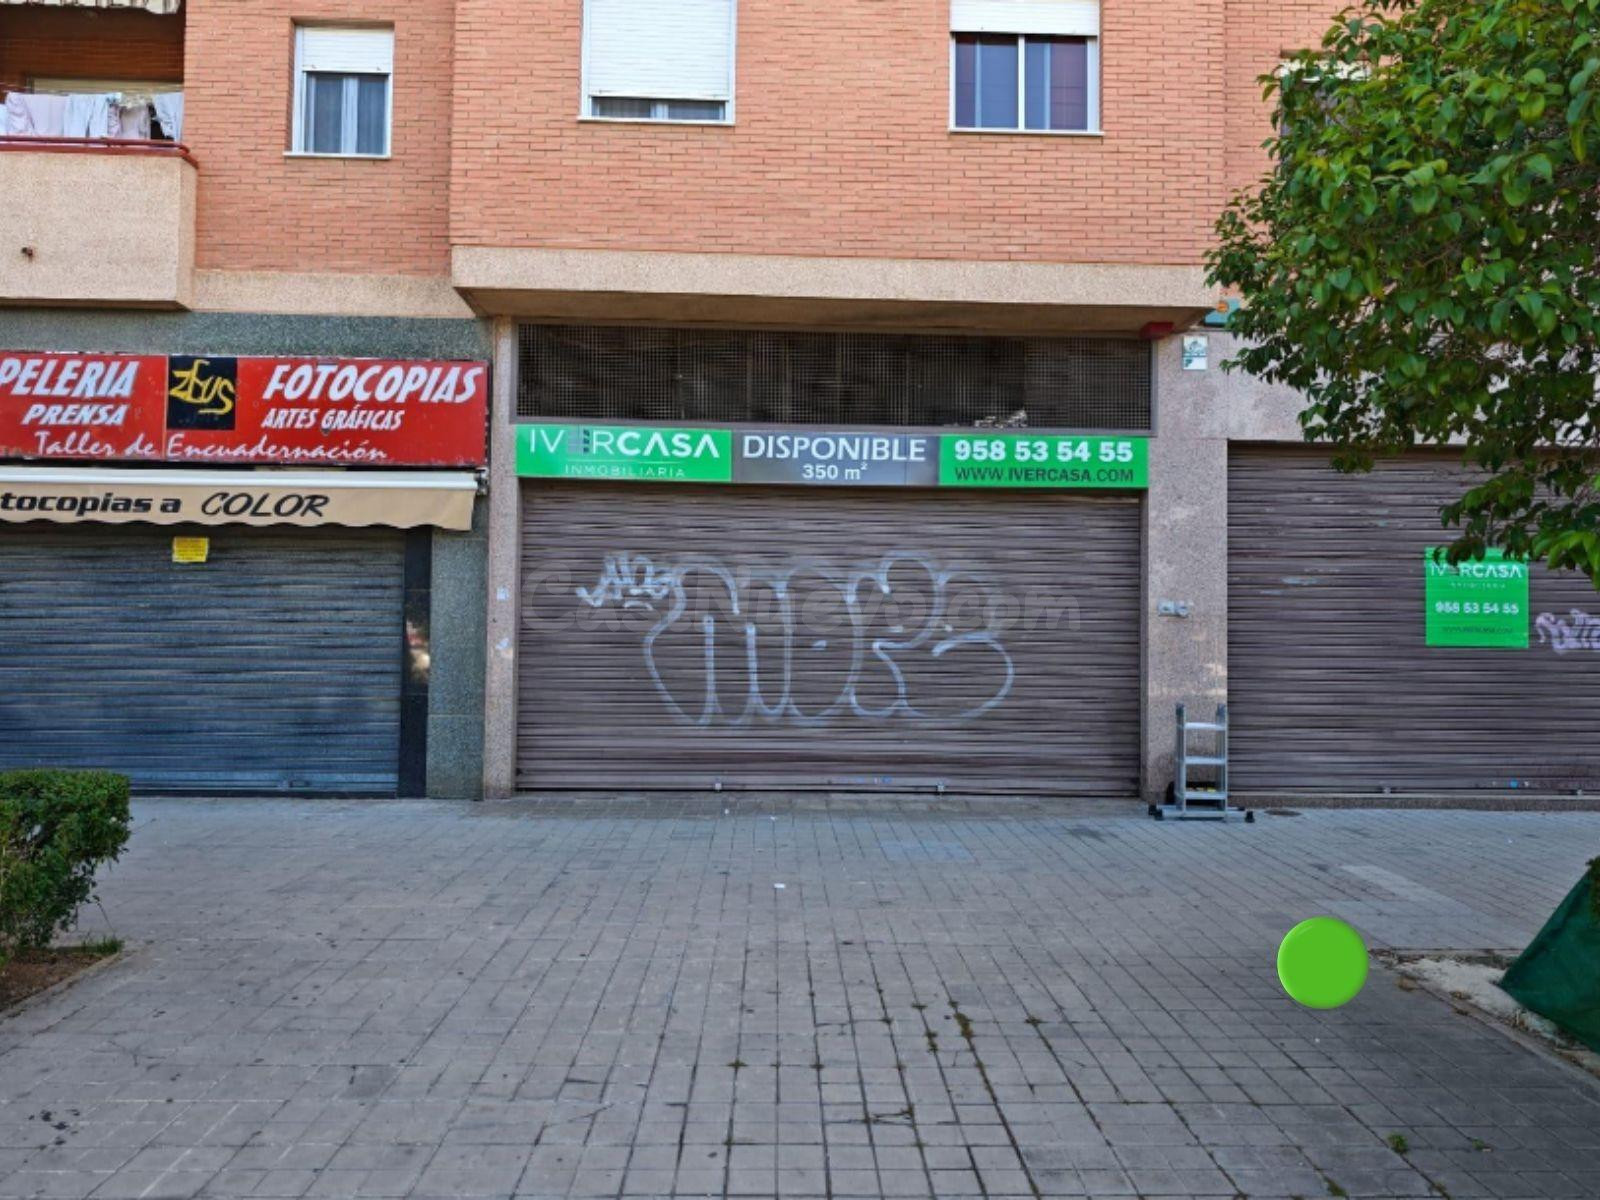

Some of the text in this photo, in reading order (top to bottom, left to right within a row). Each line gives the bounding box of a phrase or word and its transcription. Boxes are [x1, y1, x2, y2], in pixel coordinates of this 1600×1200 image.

[0, 357, 140, 398] PELERIA
[262, 363, 484, 403] FOTOCOPIAS
[21, 403, 130, 426] PRENSA
[260, 403, 405, 430] ARTES GRÁFICAS
[35, 431, 387, 459] Taller de Encuadernación
[743, 435, 927, 462] DISPONIBLE
[955, 439, 1133, 463] 958 53 54 55
[565, 463, 686, 479] INMOBILIARIA
[802, 463, 839, 481] 350
[955, 466, 1134, 483] WWW.IVERCASA.COM
[0, 491, 330, 518] tocopias a COLOR
[1482, 602, 1499, 615] 54
